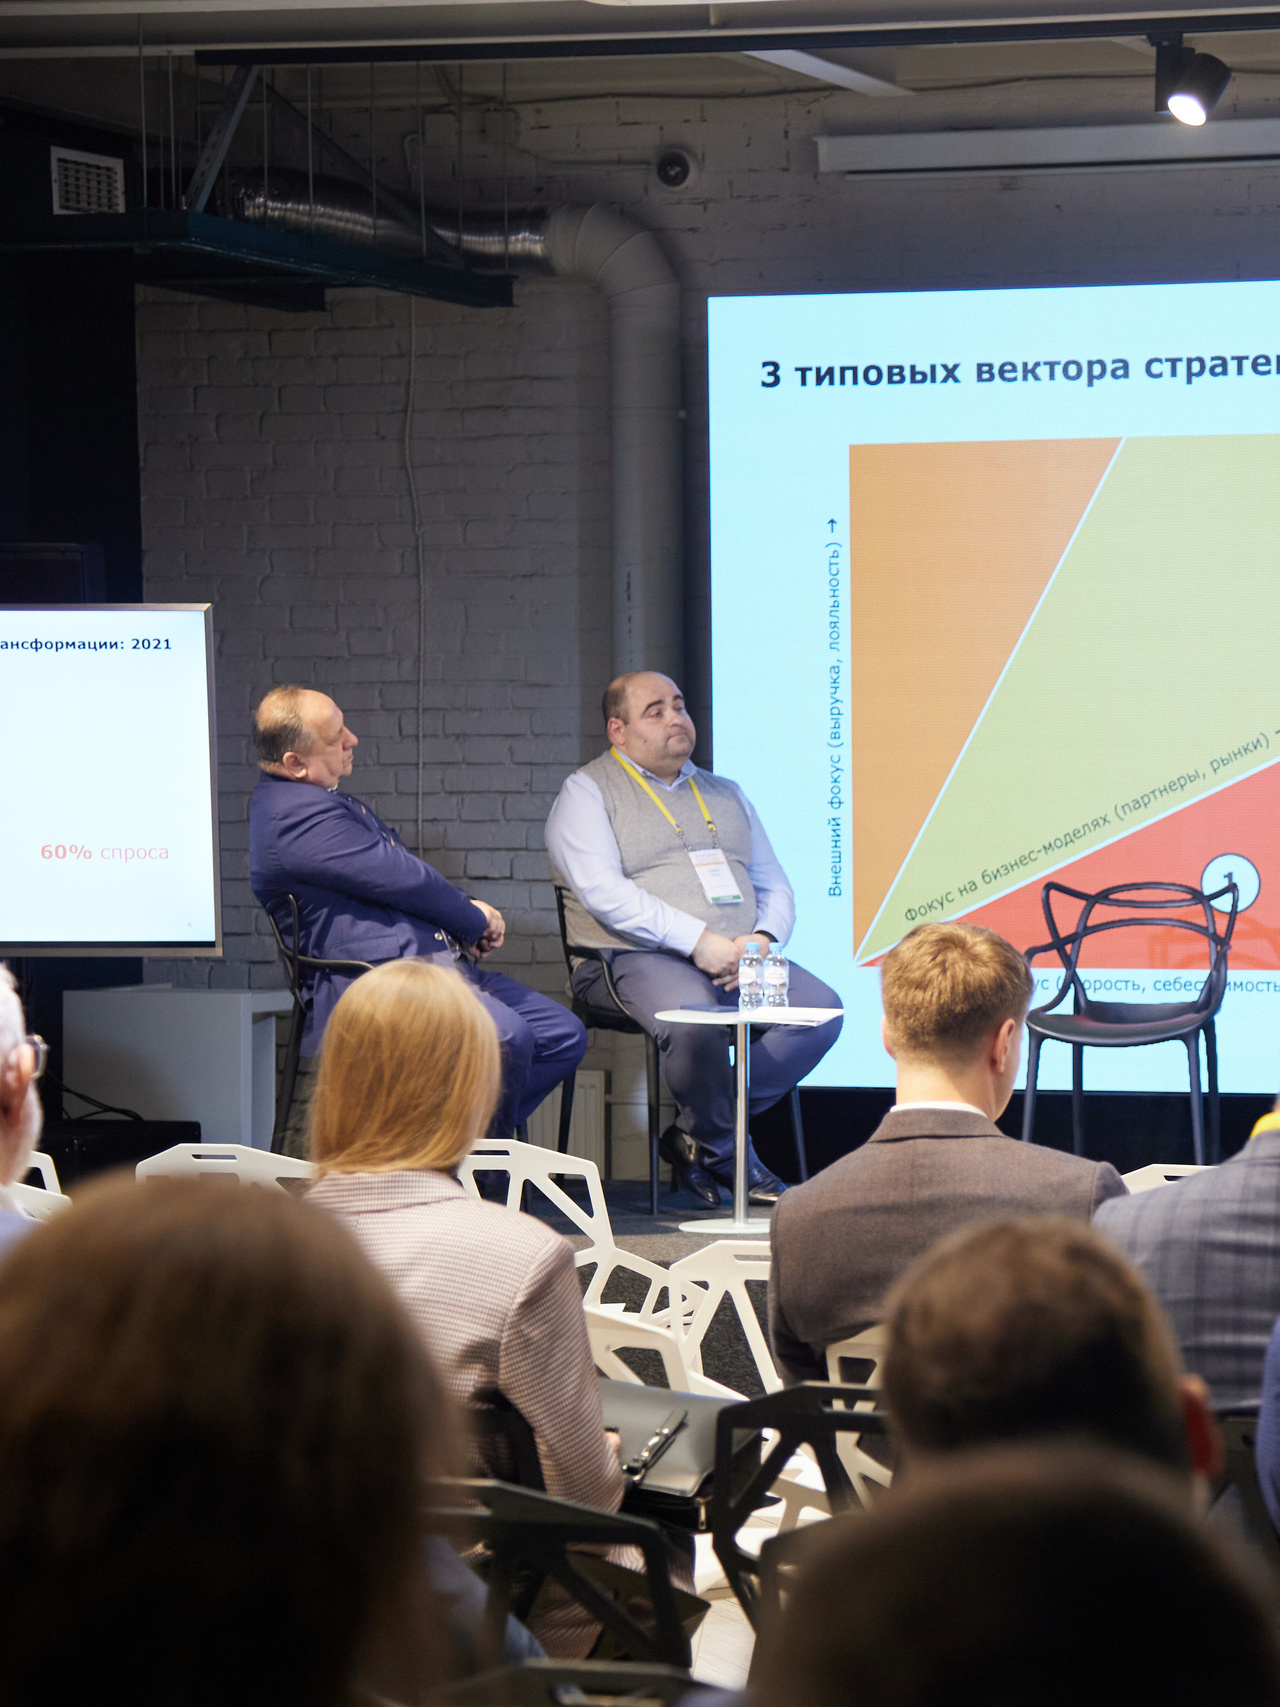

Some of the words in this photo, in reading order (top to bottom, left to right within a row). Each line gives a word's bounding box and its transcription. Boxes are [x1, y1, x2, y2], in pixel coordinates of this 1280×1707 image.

[760, 361, 781, 388] 3
[795, 362, 961, 387] типовых
[976, 357, 1130, 387] вектора
[825, 541, 843, 652] лояльность)
[131, 638, 172, 650] 2021
[827, 658, 844, 748] (выручка,
[827, 754, 844, 810] фокус
[41, 844, 92, 860] 60%
[100, 847, 169, 863] спроса
[827, 816, 842, 897] Внешний
[904, 889, 955, 924] Фокус
[957, 878, 979, 897] на
[980, 813, 1112, 886] бизнес-моделях
[1113, 769, 1207, 822] (партнеры,
[1209, 732, 1271, 774] рынки)
